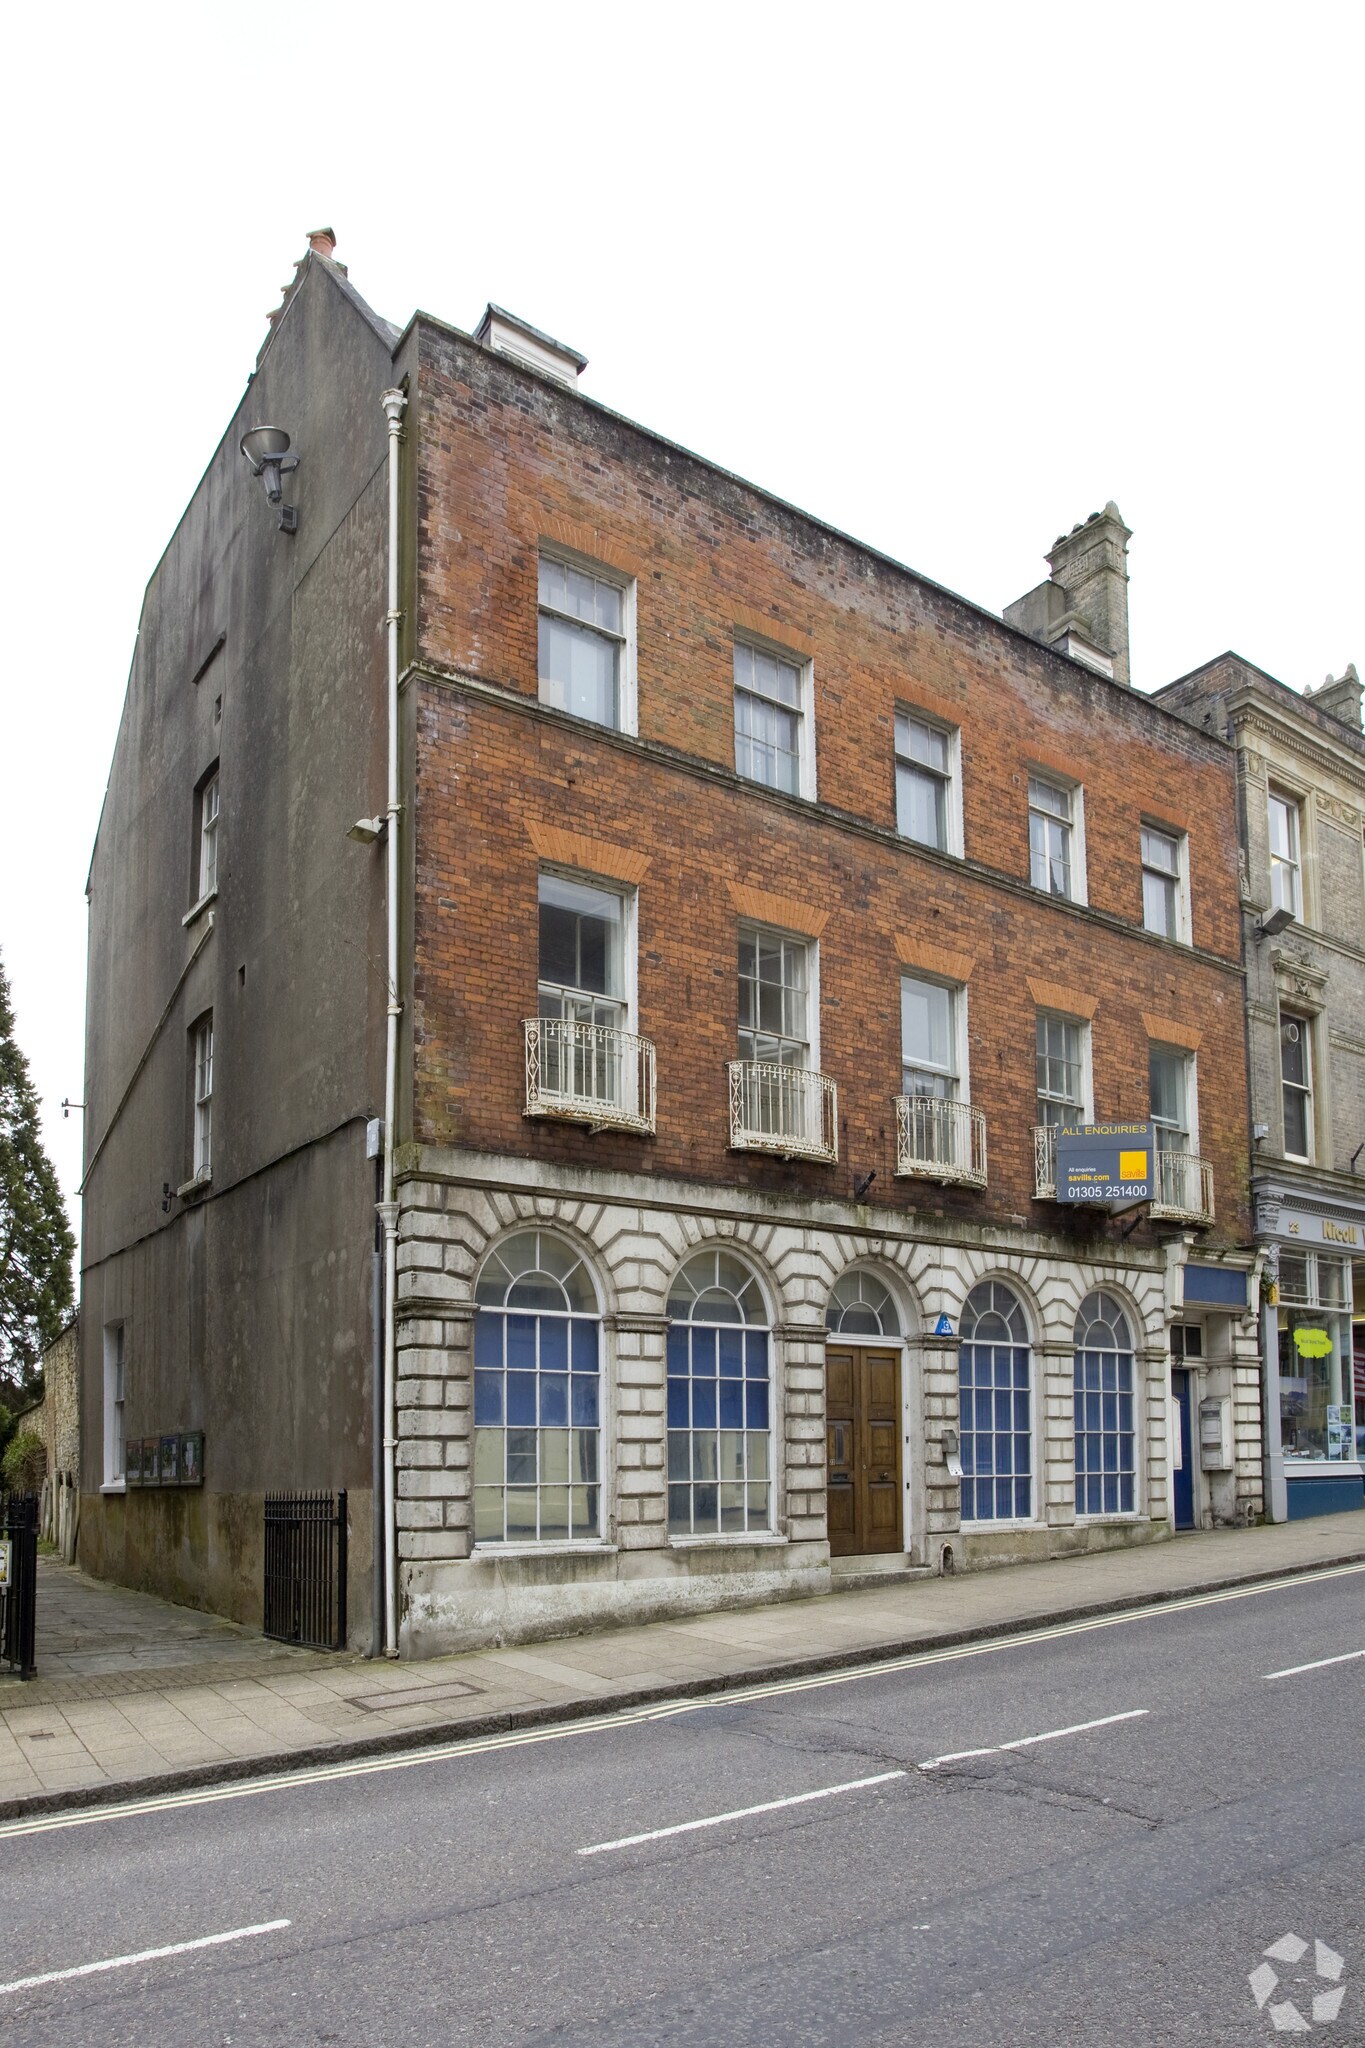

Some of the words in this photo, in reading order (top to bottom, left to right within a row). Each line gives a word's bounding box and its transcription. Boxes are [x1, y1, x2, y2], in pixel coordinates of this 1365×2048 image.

[1062, 1127, 1082, 1135] ALL
[1085, 1125, 1147, 1135] ENQUIRIES
[1121, 1169, 1145, 1178] savills
[1068, 1186, 1102, 1198] 01305
[1105, 1185, 1147, 1197] 251400
[1322, 1220, 1357, 1244] Nicoll
